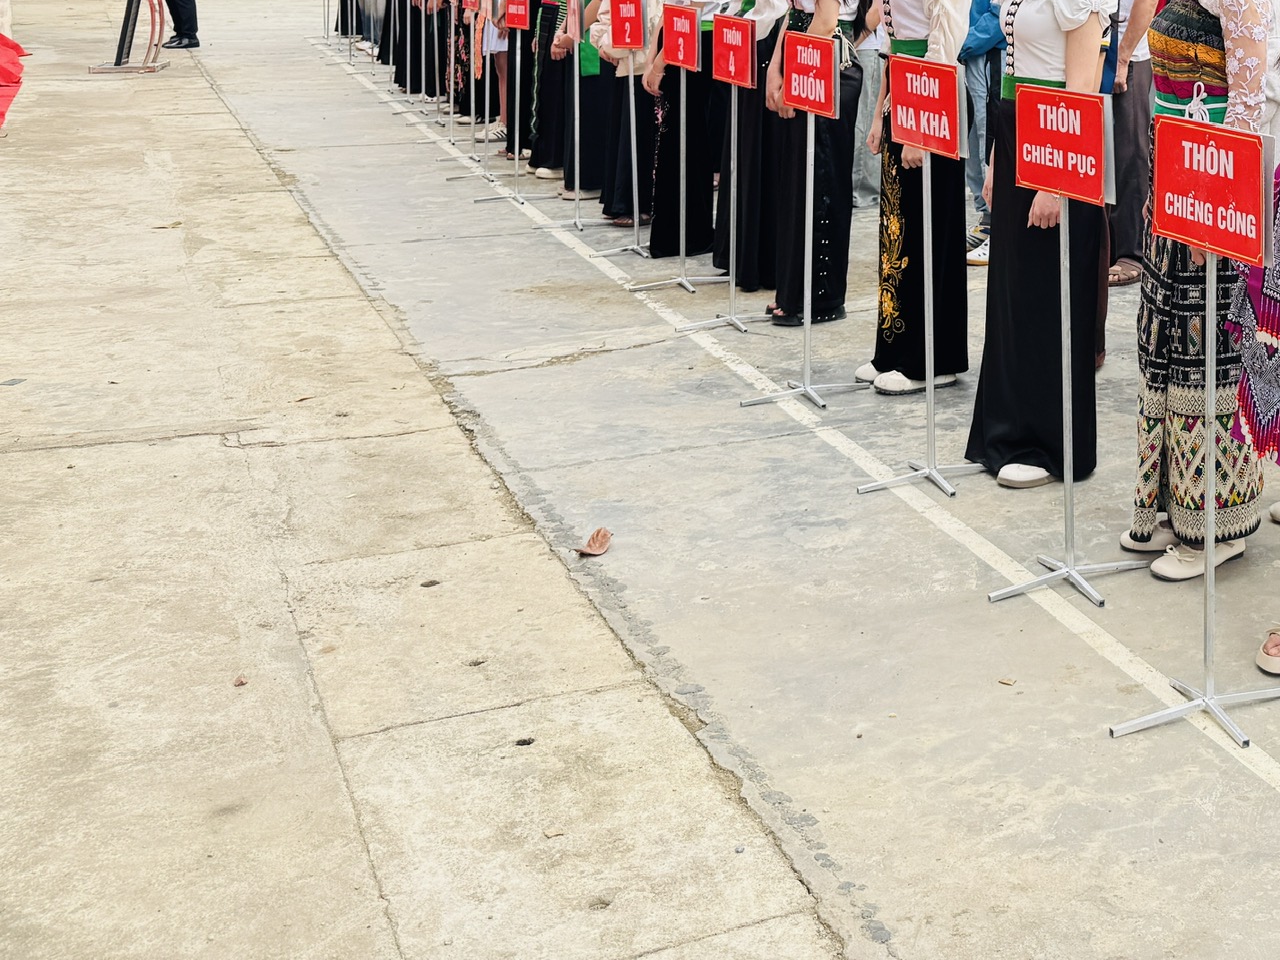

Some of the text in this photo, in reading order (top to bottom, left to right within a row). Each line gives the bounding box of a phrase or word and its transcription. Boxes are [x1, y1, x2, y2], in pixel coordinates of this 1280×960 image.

[619, 0, 636, 18] THÔN
[624, 22, 631, 43] 2
[673, 15, 690, 34] THÔN
[722, 26, 742, 47] THÔN
[677, 37, 685, 61] 3
[796, 43, 821, 68] THÔN
[728, 50, 736, 77] 4
[790, 69, 826, 103] BUỐN
[905, 72, 940, 99] THÔN
[896, 104, 951, 140] NA KHÀ
[1037, 102, 1081, 136] THÔN
[1022, 143, 1096, 178] CHIÊN PỤC
[1181, 140, 1235, 180] THÔN
[1164, 190, 1257, 239] CHIỀNG CỒNG
